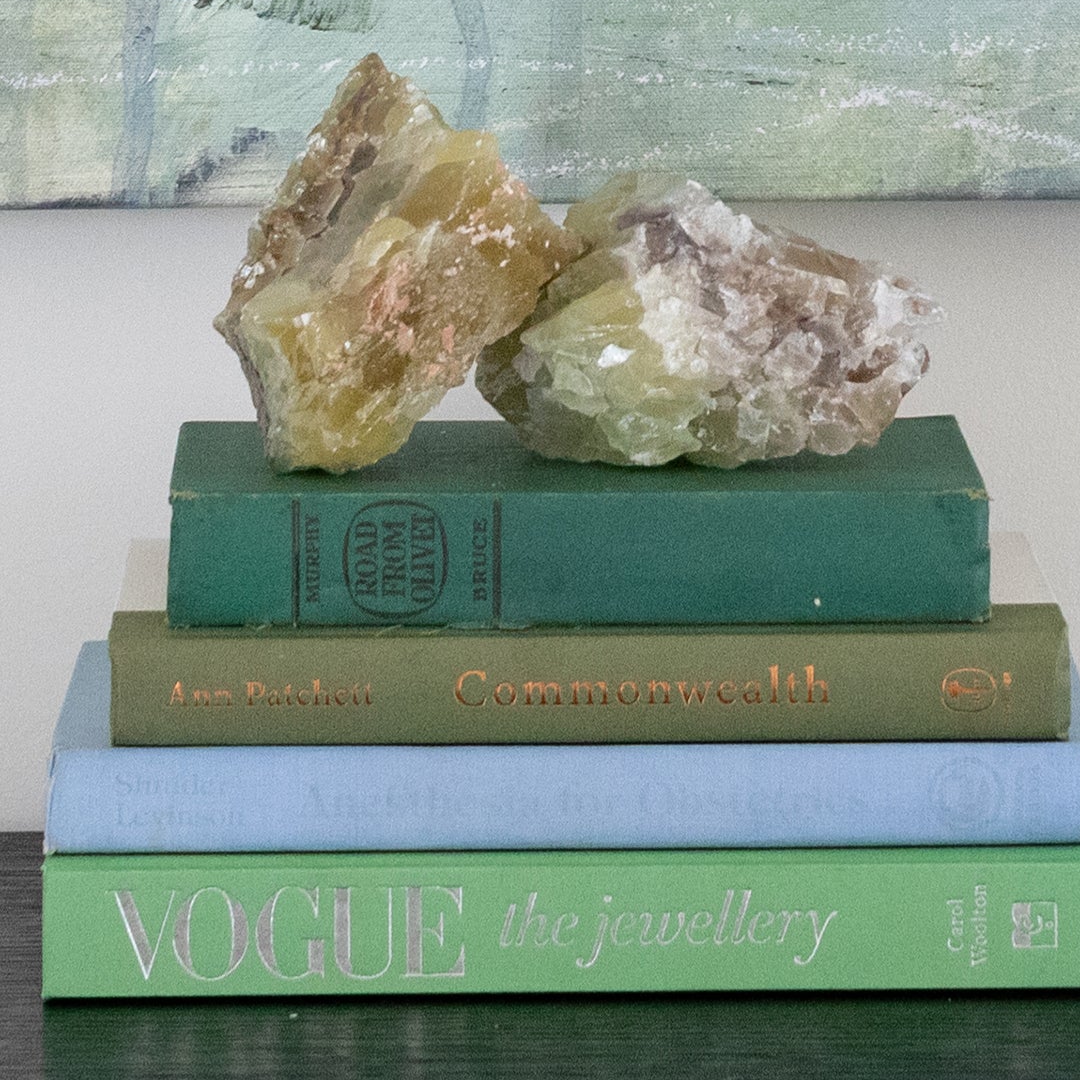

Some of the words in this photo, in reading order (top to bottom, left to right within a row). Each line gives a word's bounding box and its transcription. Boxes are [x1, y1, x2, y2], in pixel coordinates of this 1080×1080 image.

[304, 512, 321, 604] MURPHY
[354, 519, 379, 598] ROAD
[381, 519, 407, 598] FROM
[410, 512, 437, 605] OLIVET
[471, 516, 489, 602] BRUCE
[168, 680, 233, 708] Ann
[245, 678, 375, 708] Patchett
[454, 664, 831, 708] Commonwealth
[104, 885, 466, 981] VOGUE
[498, 891, 579, 948] the
[576, 888, 839, 969] jewellery
[945, 898, 965, 953] Carol
[970, 883, 989, 968] Woolton
